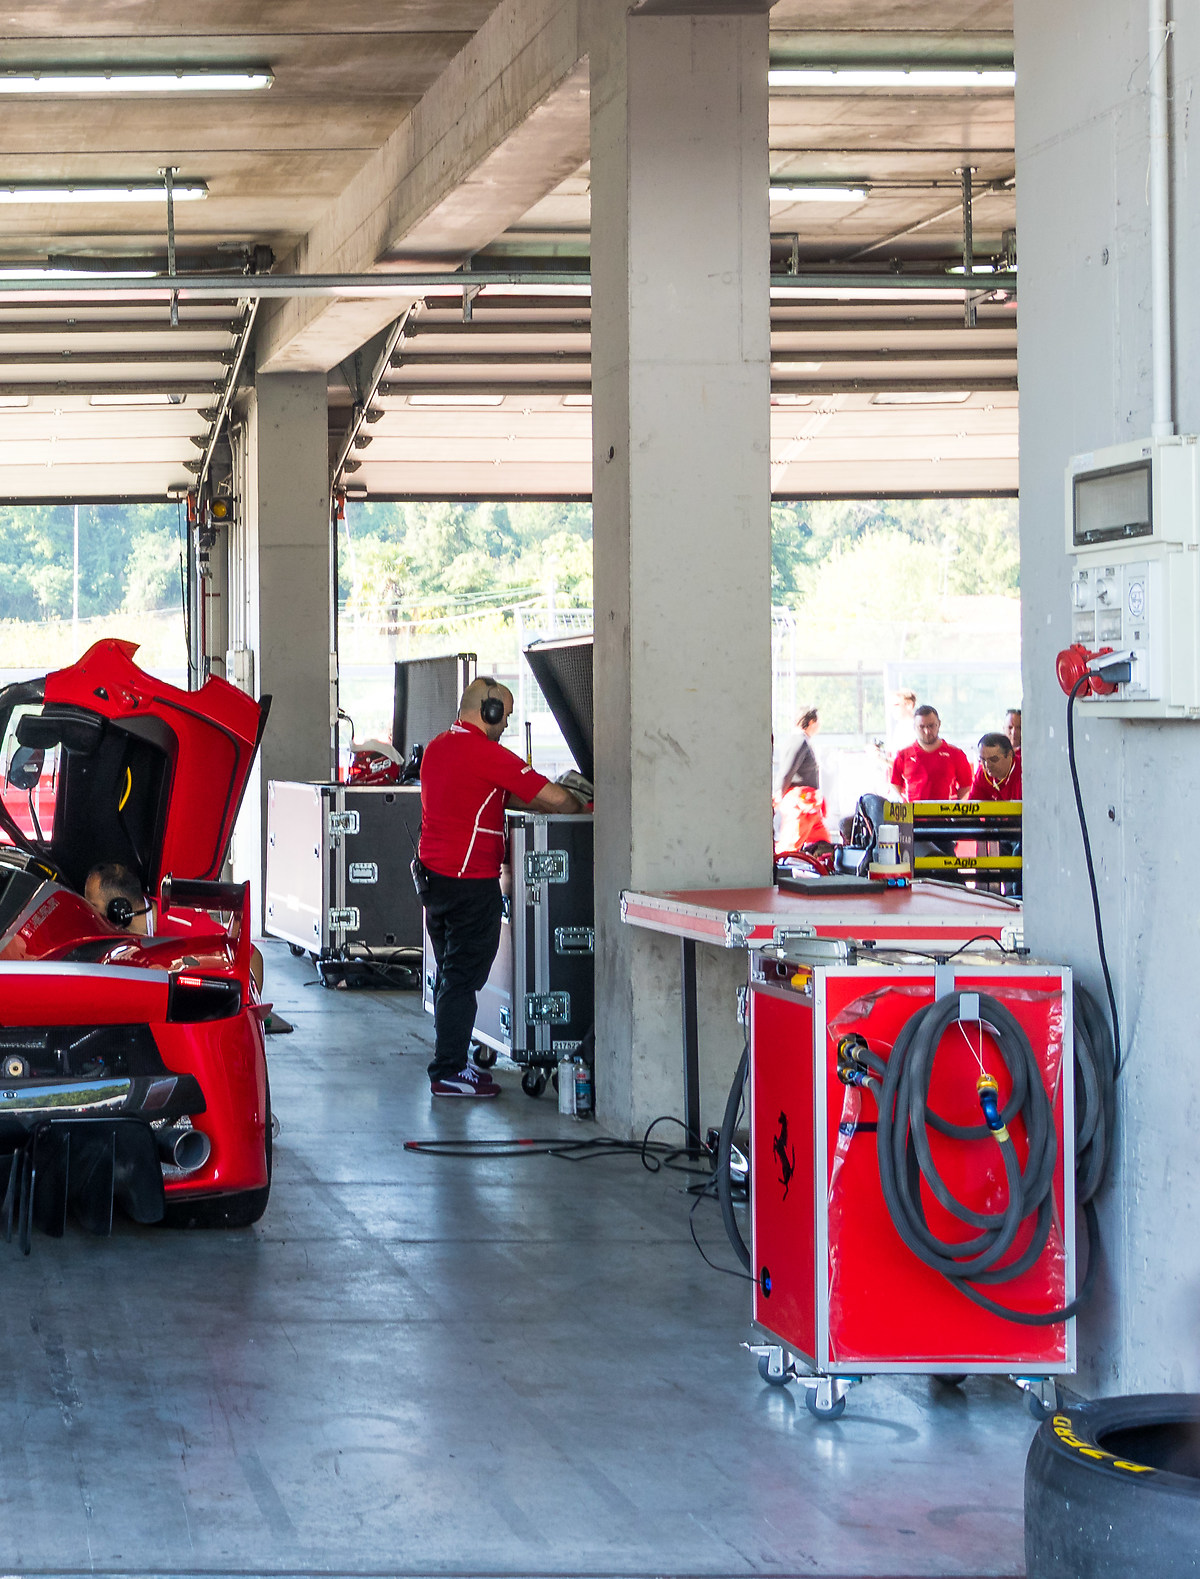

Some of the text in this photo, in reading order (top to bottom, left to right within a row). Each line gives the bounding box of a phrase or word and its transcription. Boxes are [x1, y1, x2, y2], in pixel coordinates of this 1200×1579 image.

[890, 803, 907, 820] Agip
[952, 803, 980, 814] Agip
[953, 857, 977, 868] Agip
[1053, 1415, 1156, 1473] P ZERO
